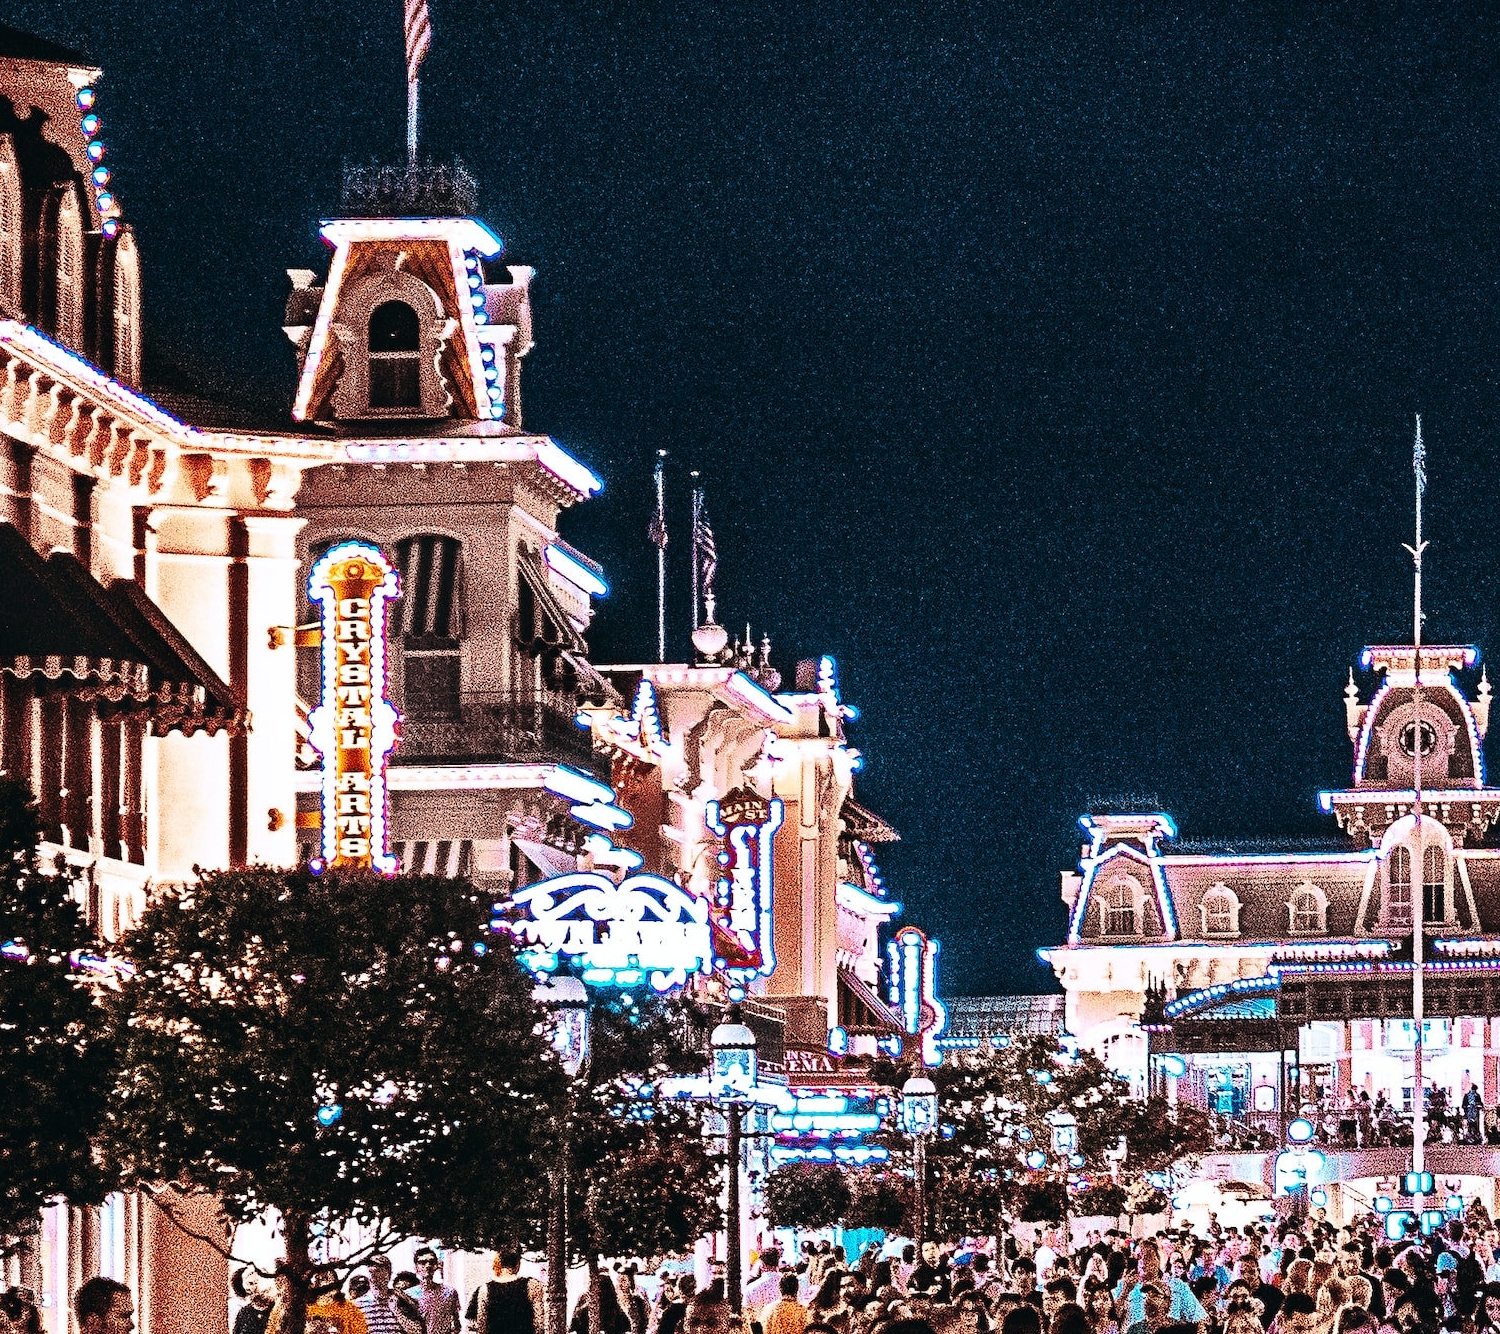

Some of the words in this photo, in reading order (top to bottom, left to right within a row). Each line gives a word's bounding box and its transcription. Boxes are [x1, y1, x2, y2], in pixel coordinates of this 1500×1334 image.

[337, 597, 371, 749] CRYSTAL
[337, 771, 370, 858] ARTS
[720, 800, 764, 818] MAIN
